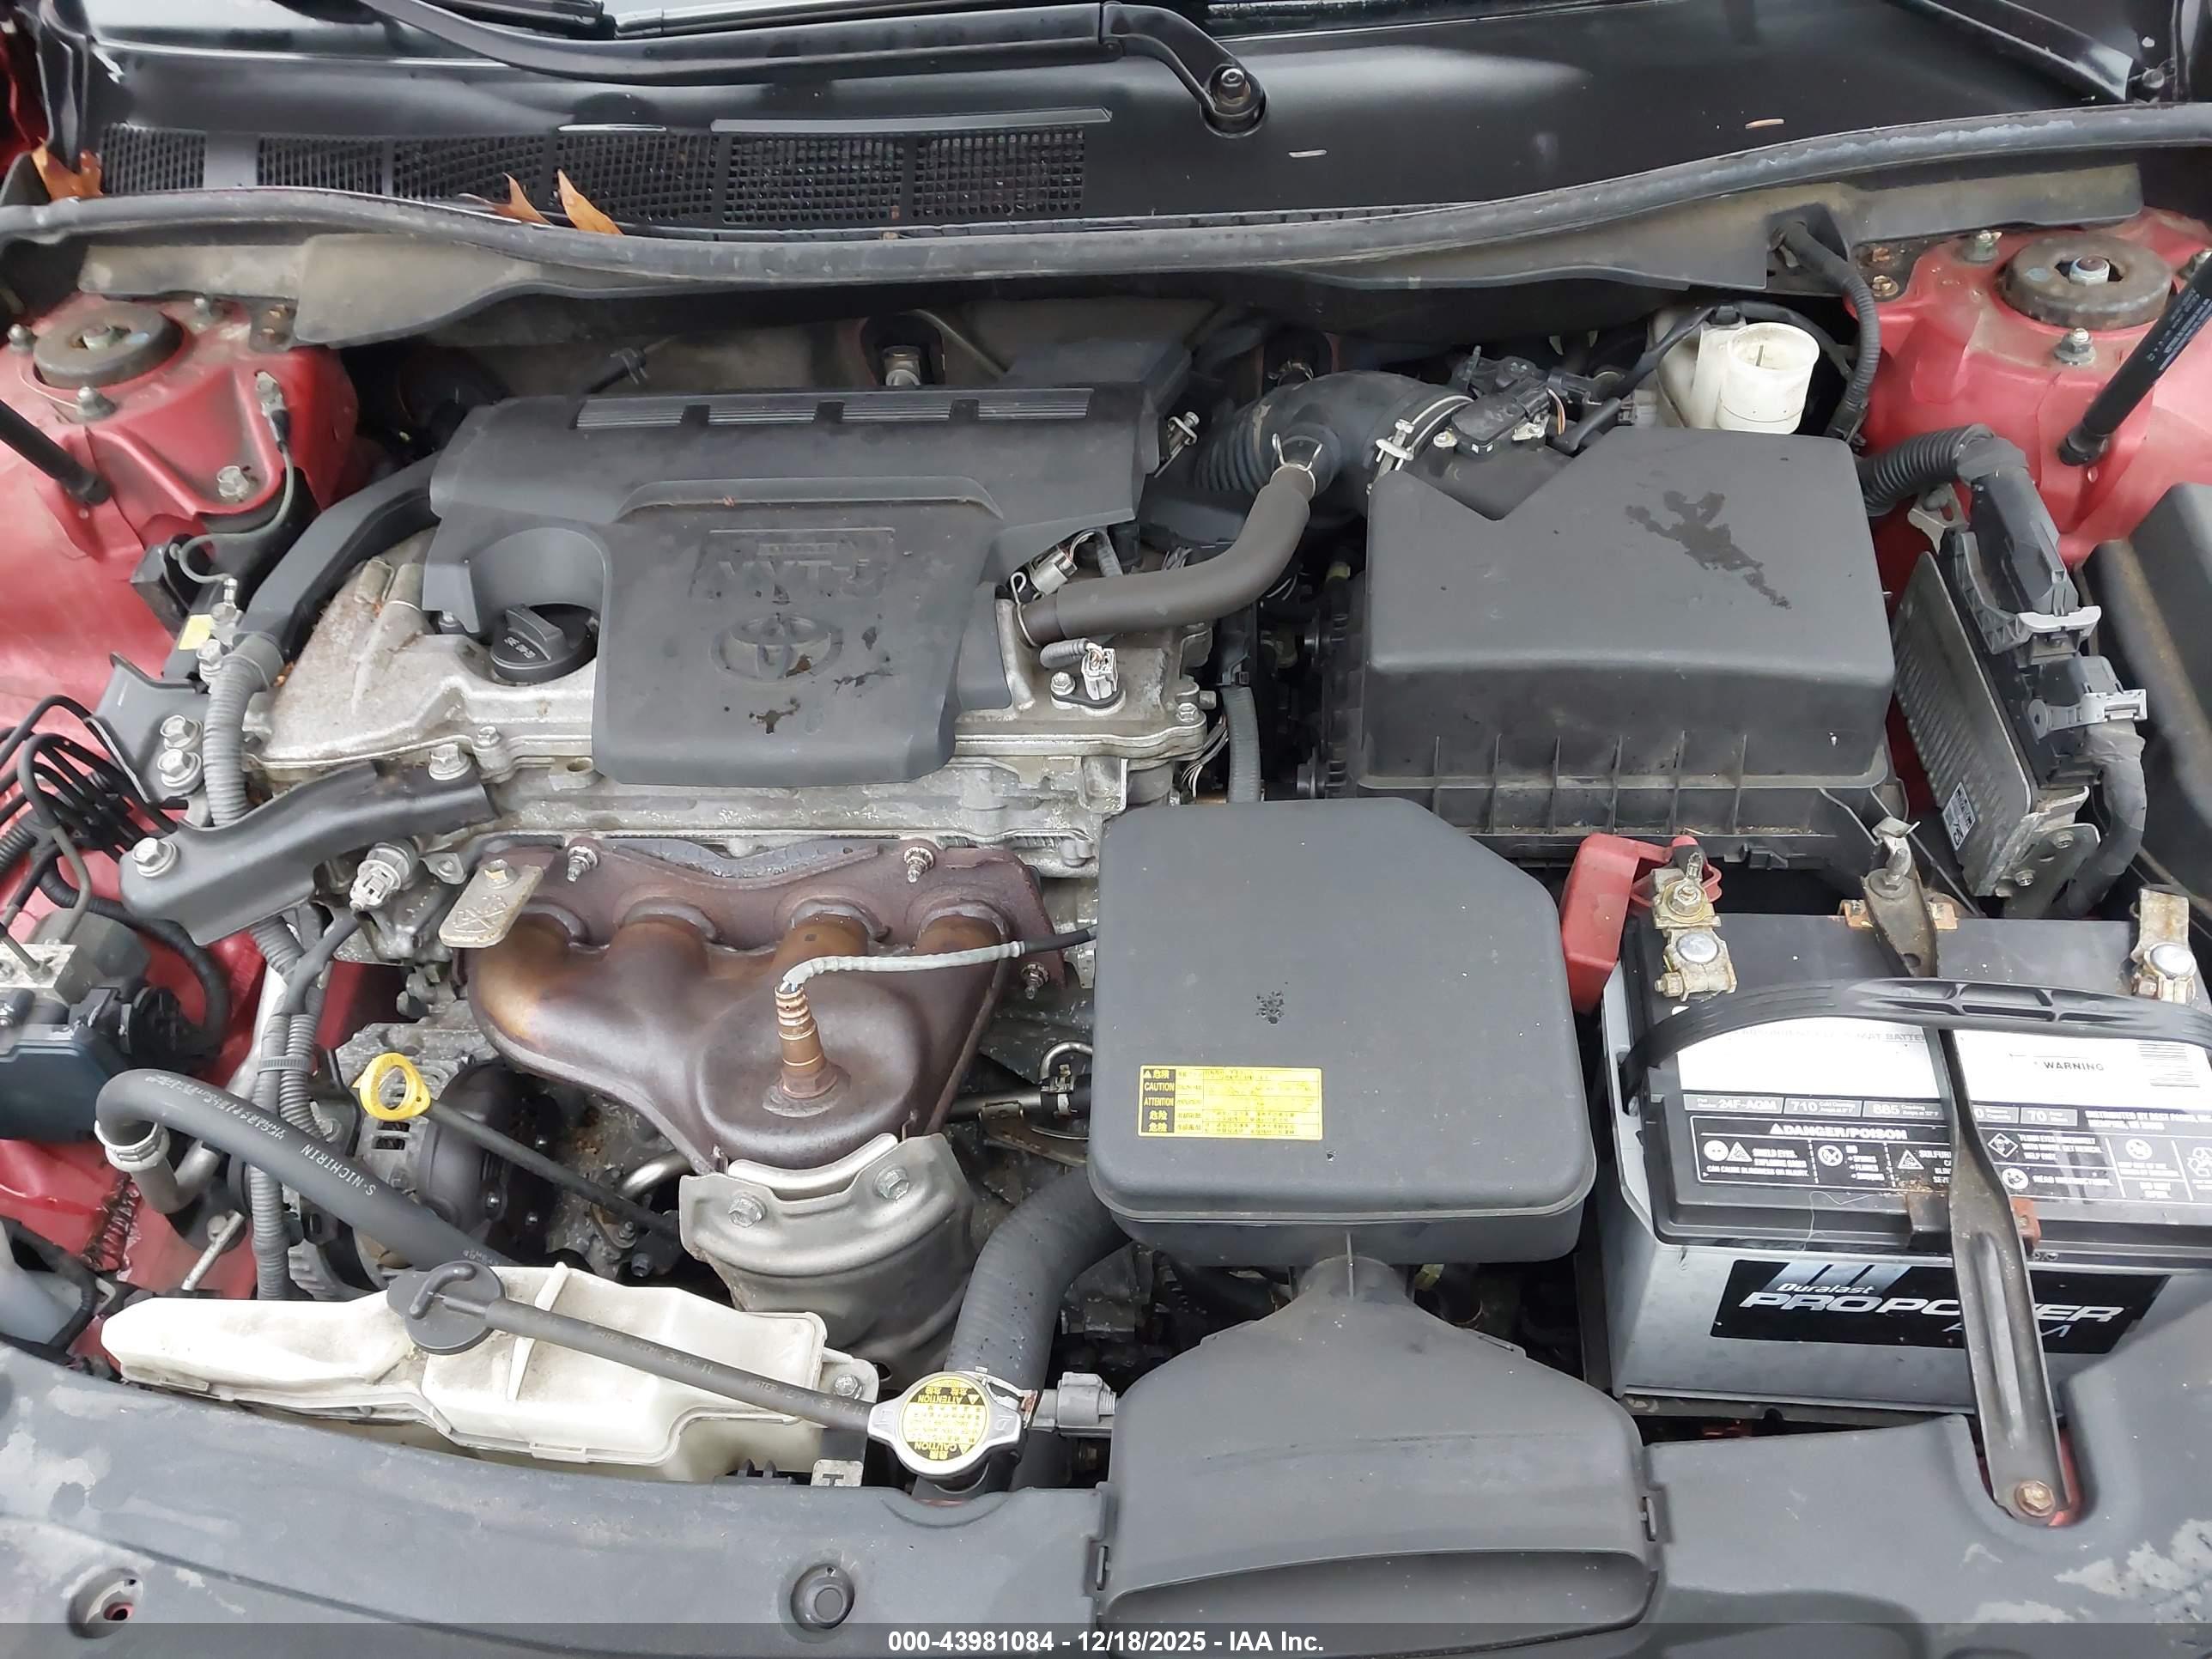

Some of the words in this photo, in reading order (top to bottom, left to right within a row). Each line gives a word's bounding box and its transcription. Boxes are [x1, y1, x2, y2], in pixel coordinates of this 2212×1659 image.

[2044, 1061, 2105, 1072] WARNING
[1144, 1082, 1175, 1091] CAUTION
[1144, 1097, 1175, 1107] ATTENTION
[1718, 1099, 1778, 1110] 24F-AGM
[1790, 1101, 1818, 1111] 710
[2027, 1110, 2047, 1121] 70
[1783, 1124, 1909, 1140] DANGER/POISON
[1776, 1282, 1875, 1294] Duralast
[1739, 1292, 2125, 1322] PROPOER
[917, 1395, 963, 1404] ATTENTION
[915, 1442, 957, 1452] CAUTION
